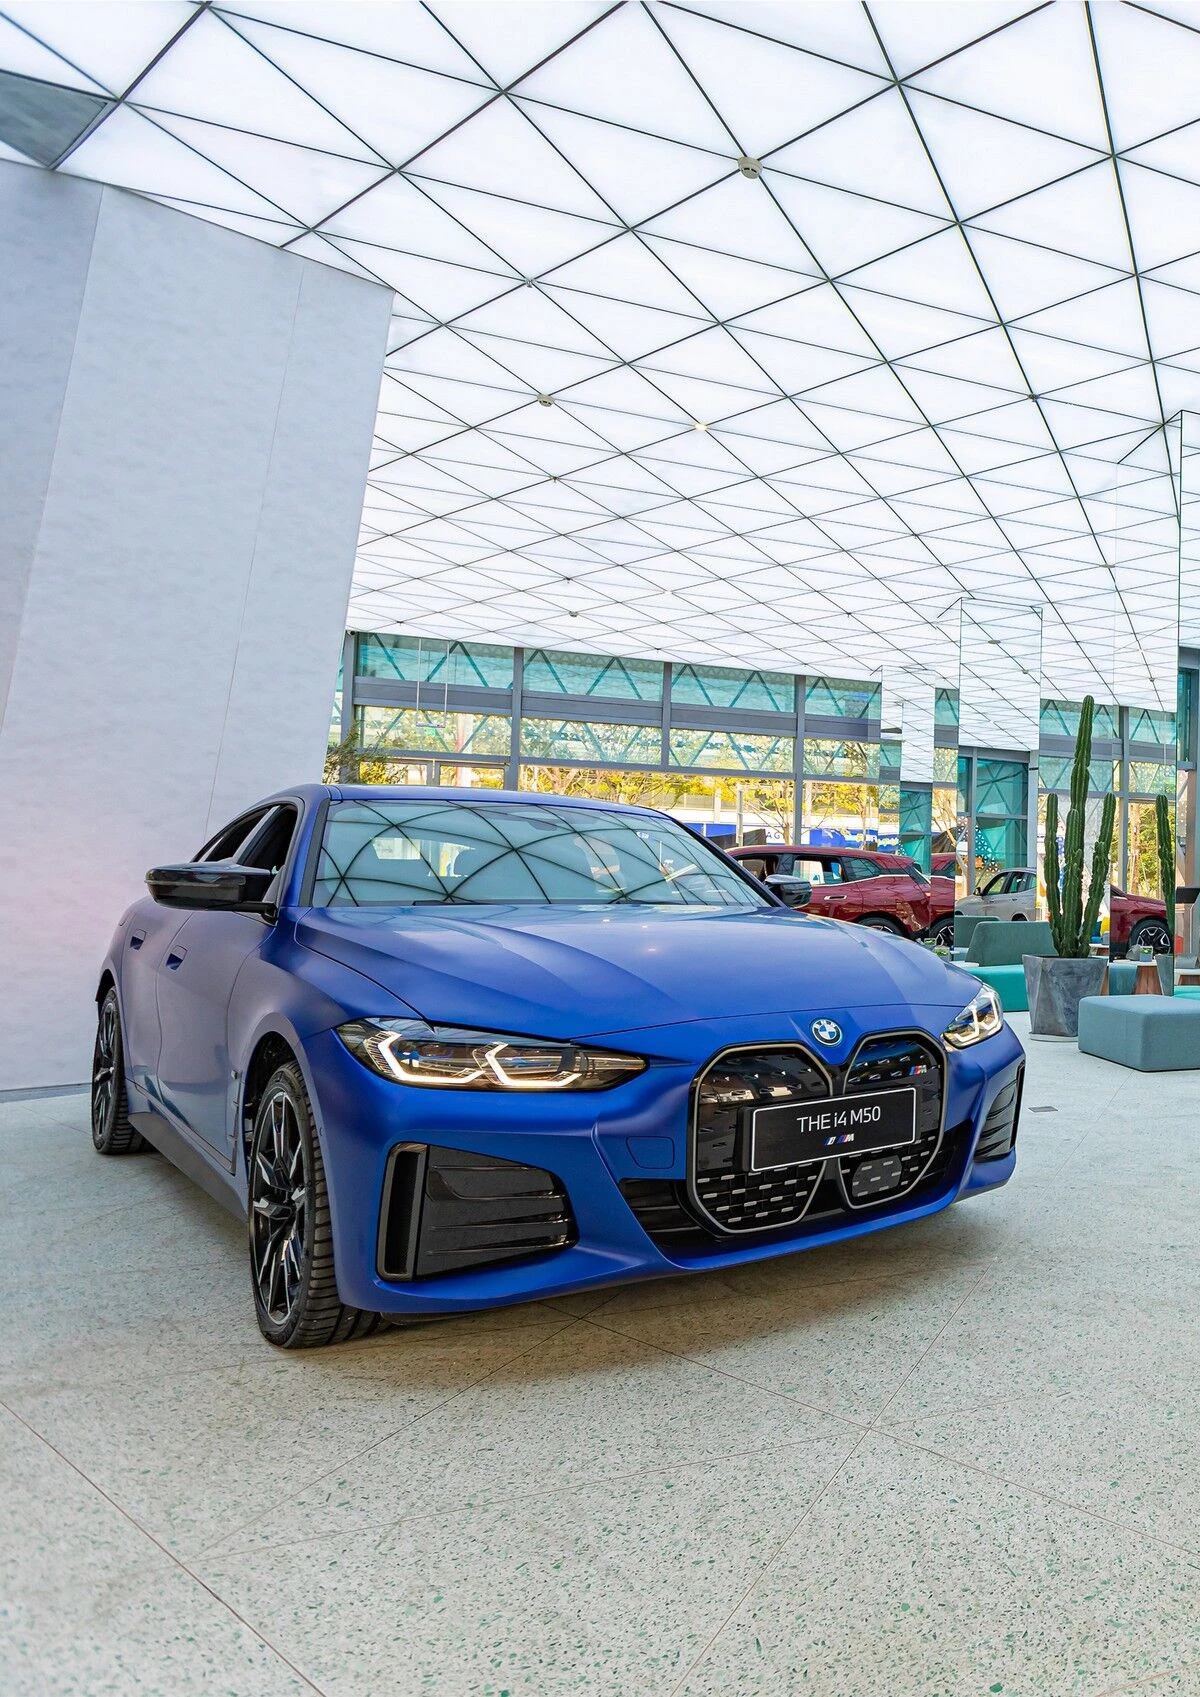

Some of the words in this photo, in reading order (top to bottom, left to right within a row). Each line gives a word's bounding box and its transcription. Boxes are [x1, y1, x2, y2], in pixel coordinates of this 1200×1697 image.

[797, 1112, 831, 1133] THE
[834, 1110, 847, 1127] i4
[850, 1105, 881, 1125] M50
